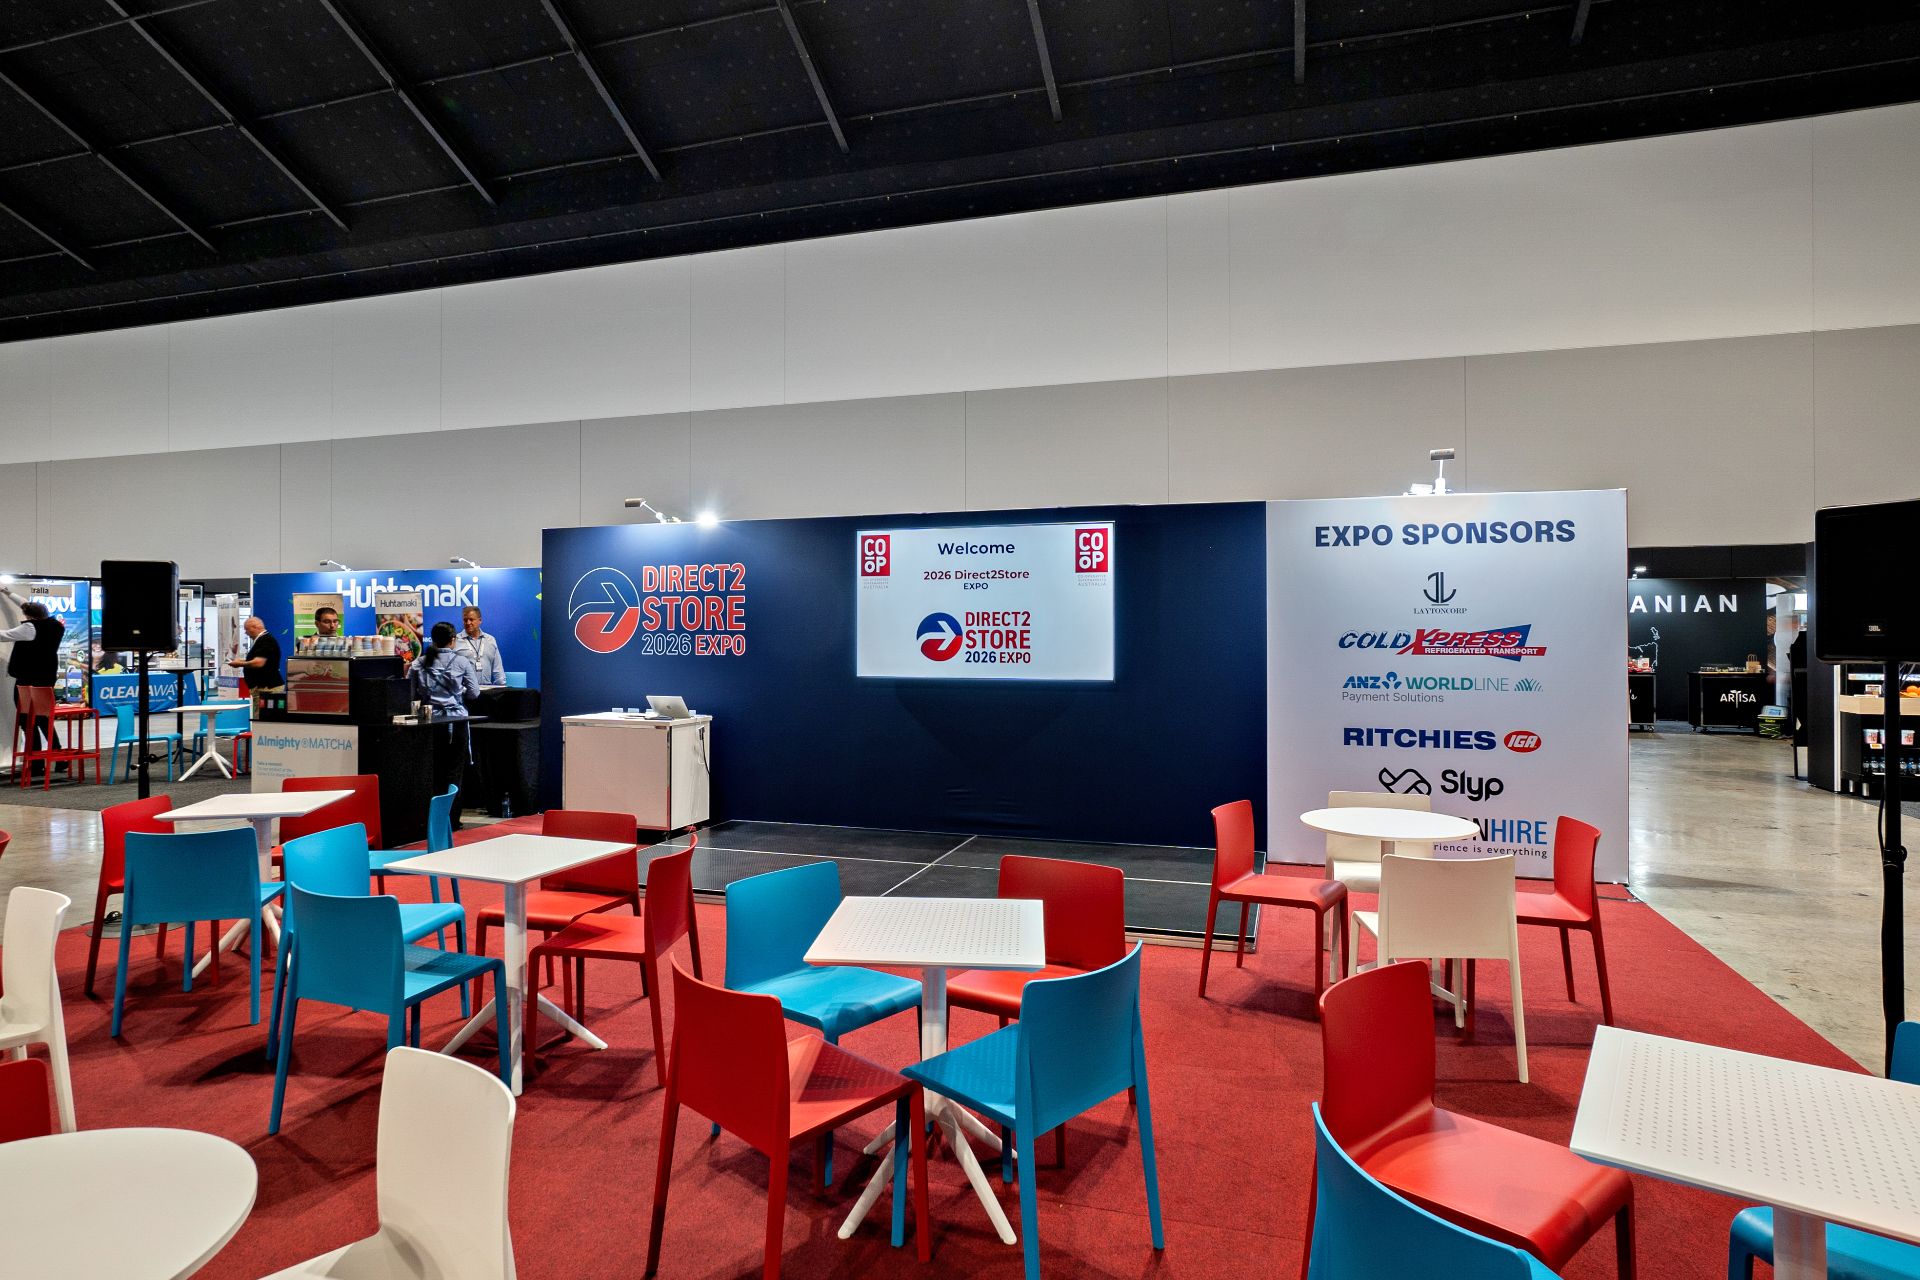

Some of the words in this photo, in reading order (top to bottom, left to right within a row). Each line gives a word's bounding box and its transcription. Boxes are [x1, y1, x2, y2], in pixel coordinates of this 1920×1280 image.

[1314, 524, 1394, 547] EXPO
[1402, 520, 1576, 545] SPONSORS
[938, 542, 1015, 555] Welcome
[642, 563, 746, 592] DIRECT2
[924, 571, 952, 580] 2026
[954, 569, 1030, 580] Direct2Store
[963, 582, 988, 590] EXPO
[380, 599, 417, 608] Huhtamaki
[1413, 607, 1468, 615] LAYTONCORP
[1630, 595, 1738, 613] ANIAN
[642, 596, 746, 631] STORE
[965, 611, 1031, 627] DIRECT2
[642, 633, 692, 655] 2026
[695, 635, 746, 656] EXPO
[965, 629, 1031, 649] STORE
[965, 651, 997, 663] 2026
[999, 652, 1031, 664] EXPO
[1342, 676, 1382, 690] ANZ
[1405, 677, 1510, 692] WORLDLINE
[1342, 691, 1390, 703] Payment
[1393, 692, 1444, 703] Solutions
[1720, 690, 1757, 709] ARTISA
[257, 736, 300, 750] Almighty
[309, 738, 353, 751] MATCHA
[1344, 727, 1497, 750] RITCHIES
[1507, 734, 1538, 748] IGA
[1440, 769, 1504, 802] Slyp
[1473, 844, 1482, 853] is
[1487, 847, 1548, 859] everything
